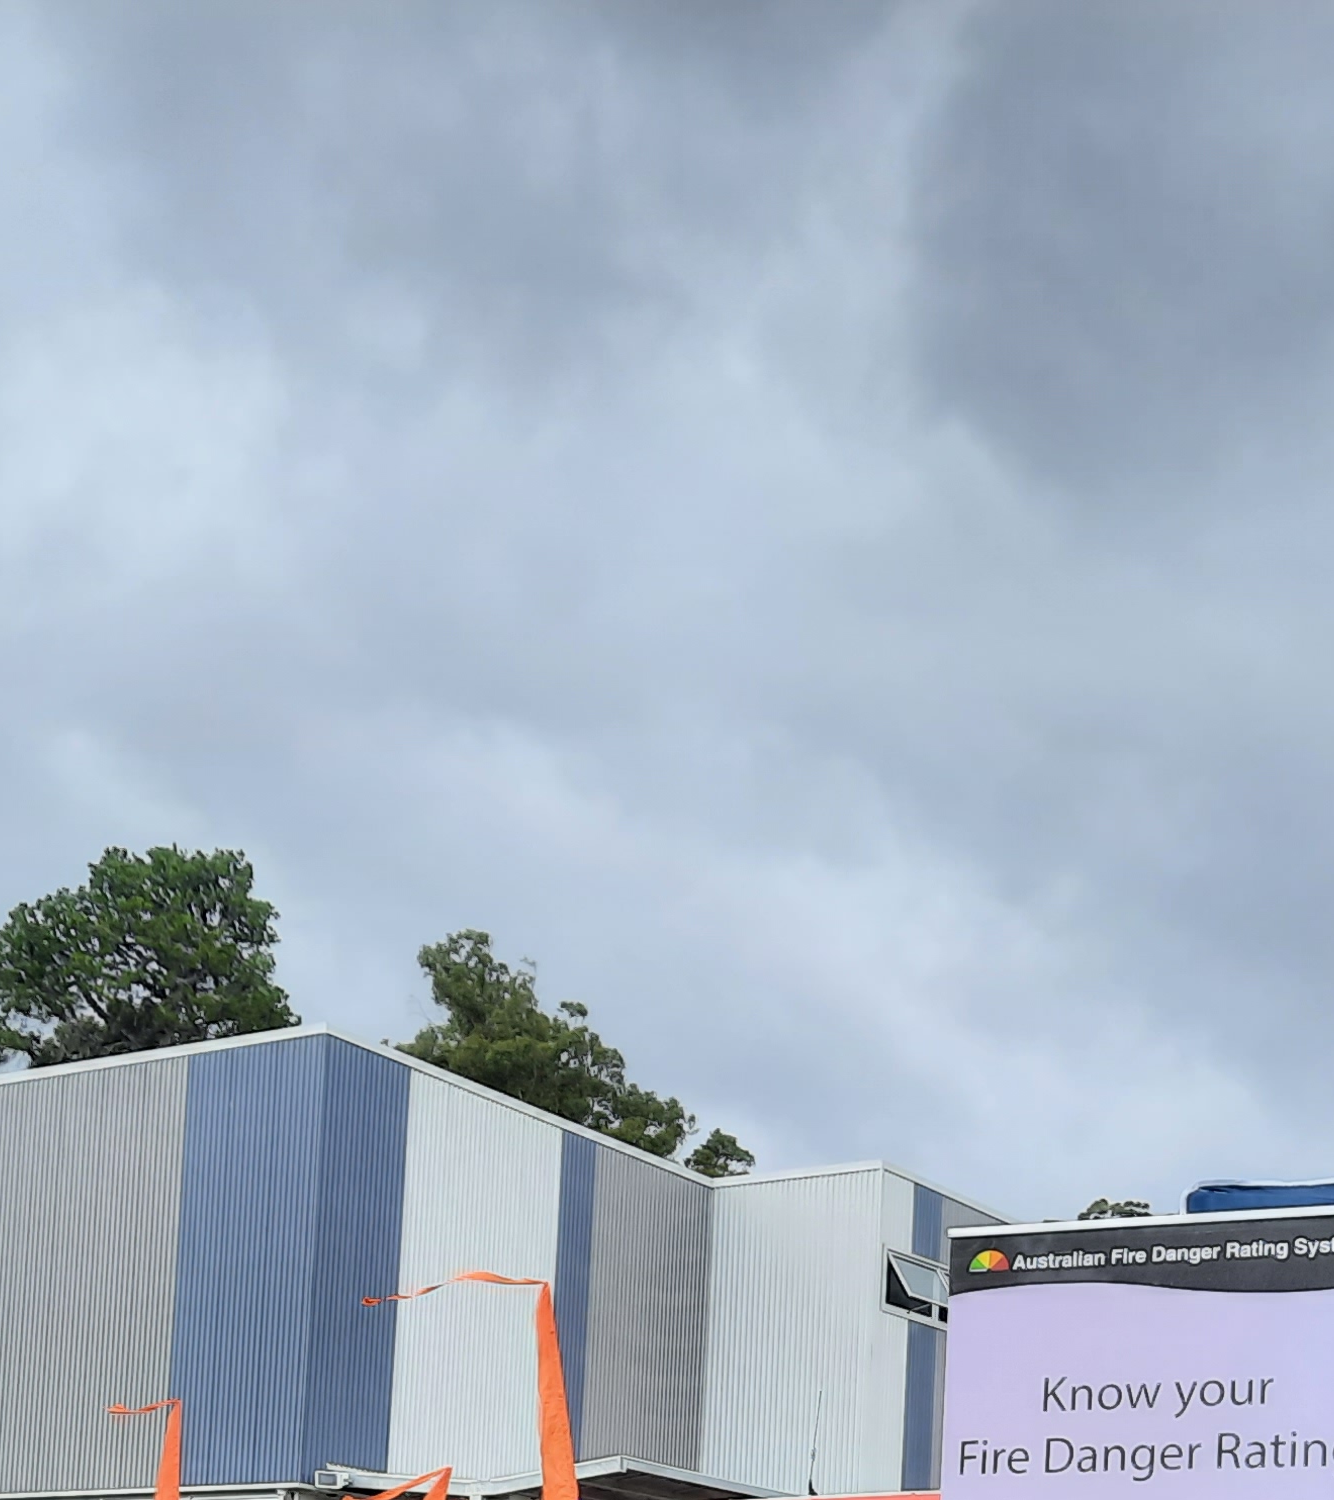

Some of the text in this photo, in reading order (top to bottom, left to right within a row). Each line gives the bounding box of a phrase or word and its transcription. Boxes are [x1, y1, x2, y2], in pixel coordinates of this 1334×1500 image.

[1012, 1252, 1105, 1271] Australian
[1111, 1249, 1146, 1265] Fire
[1152, 1244, 1221, 1264] Danger
[1225, 1240, 1288, 1259] Rating
[1042, 1376, 1274, 1418] Know your
[959, 1438, 1030, 1475] Fire
[1044, 1436, 1202, 1481] Danger
